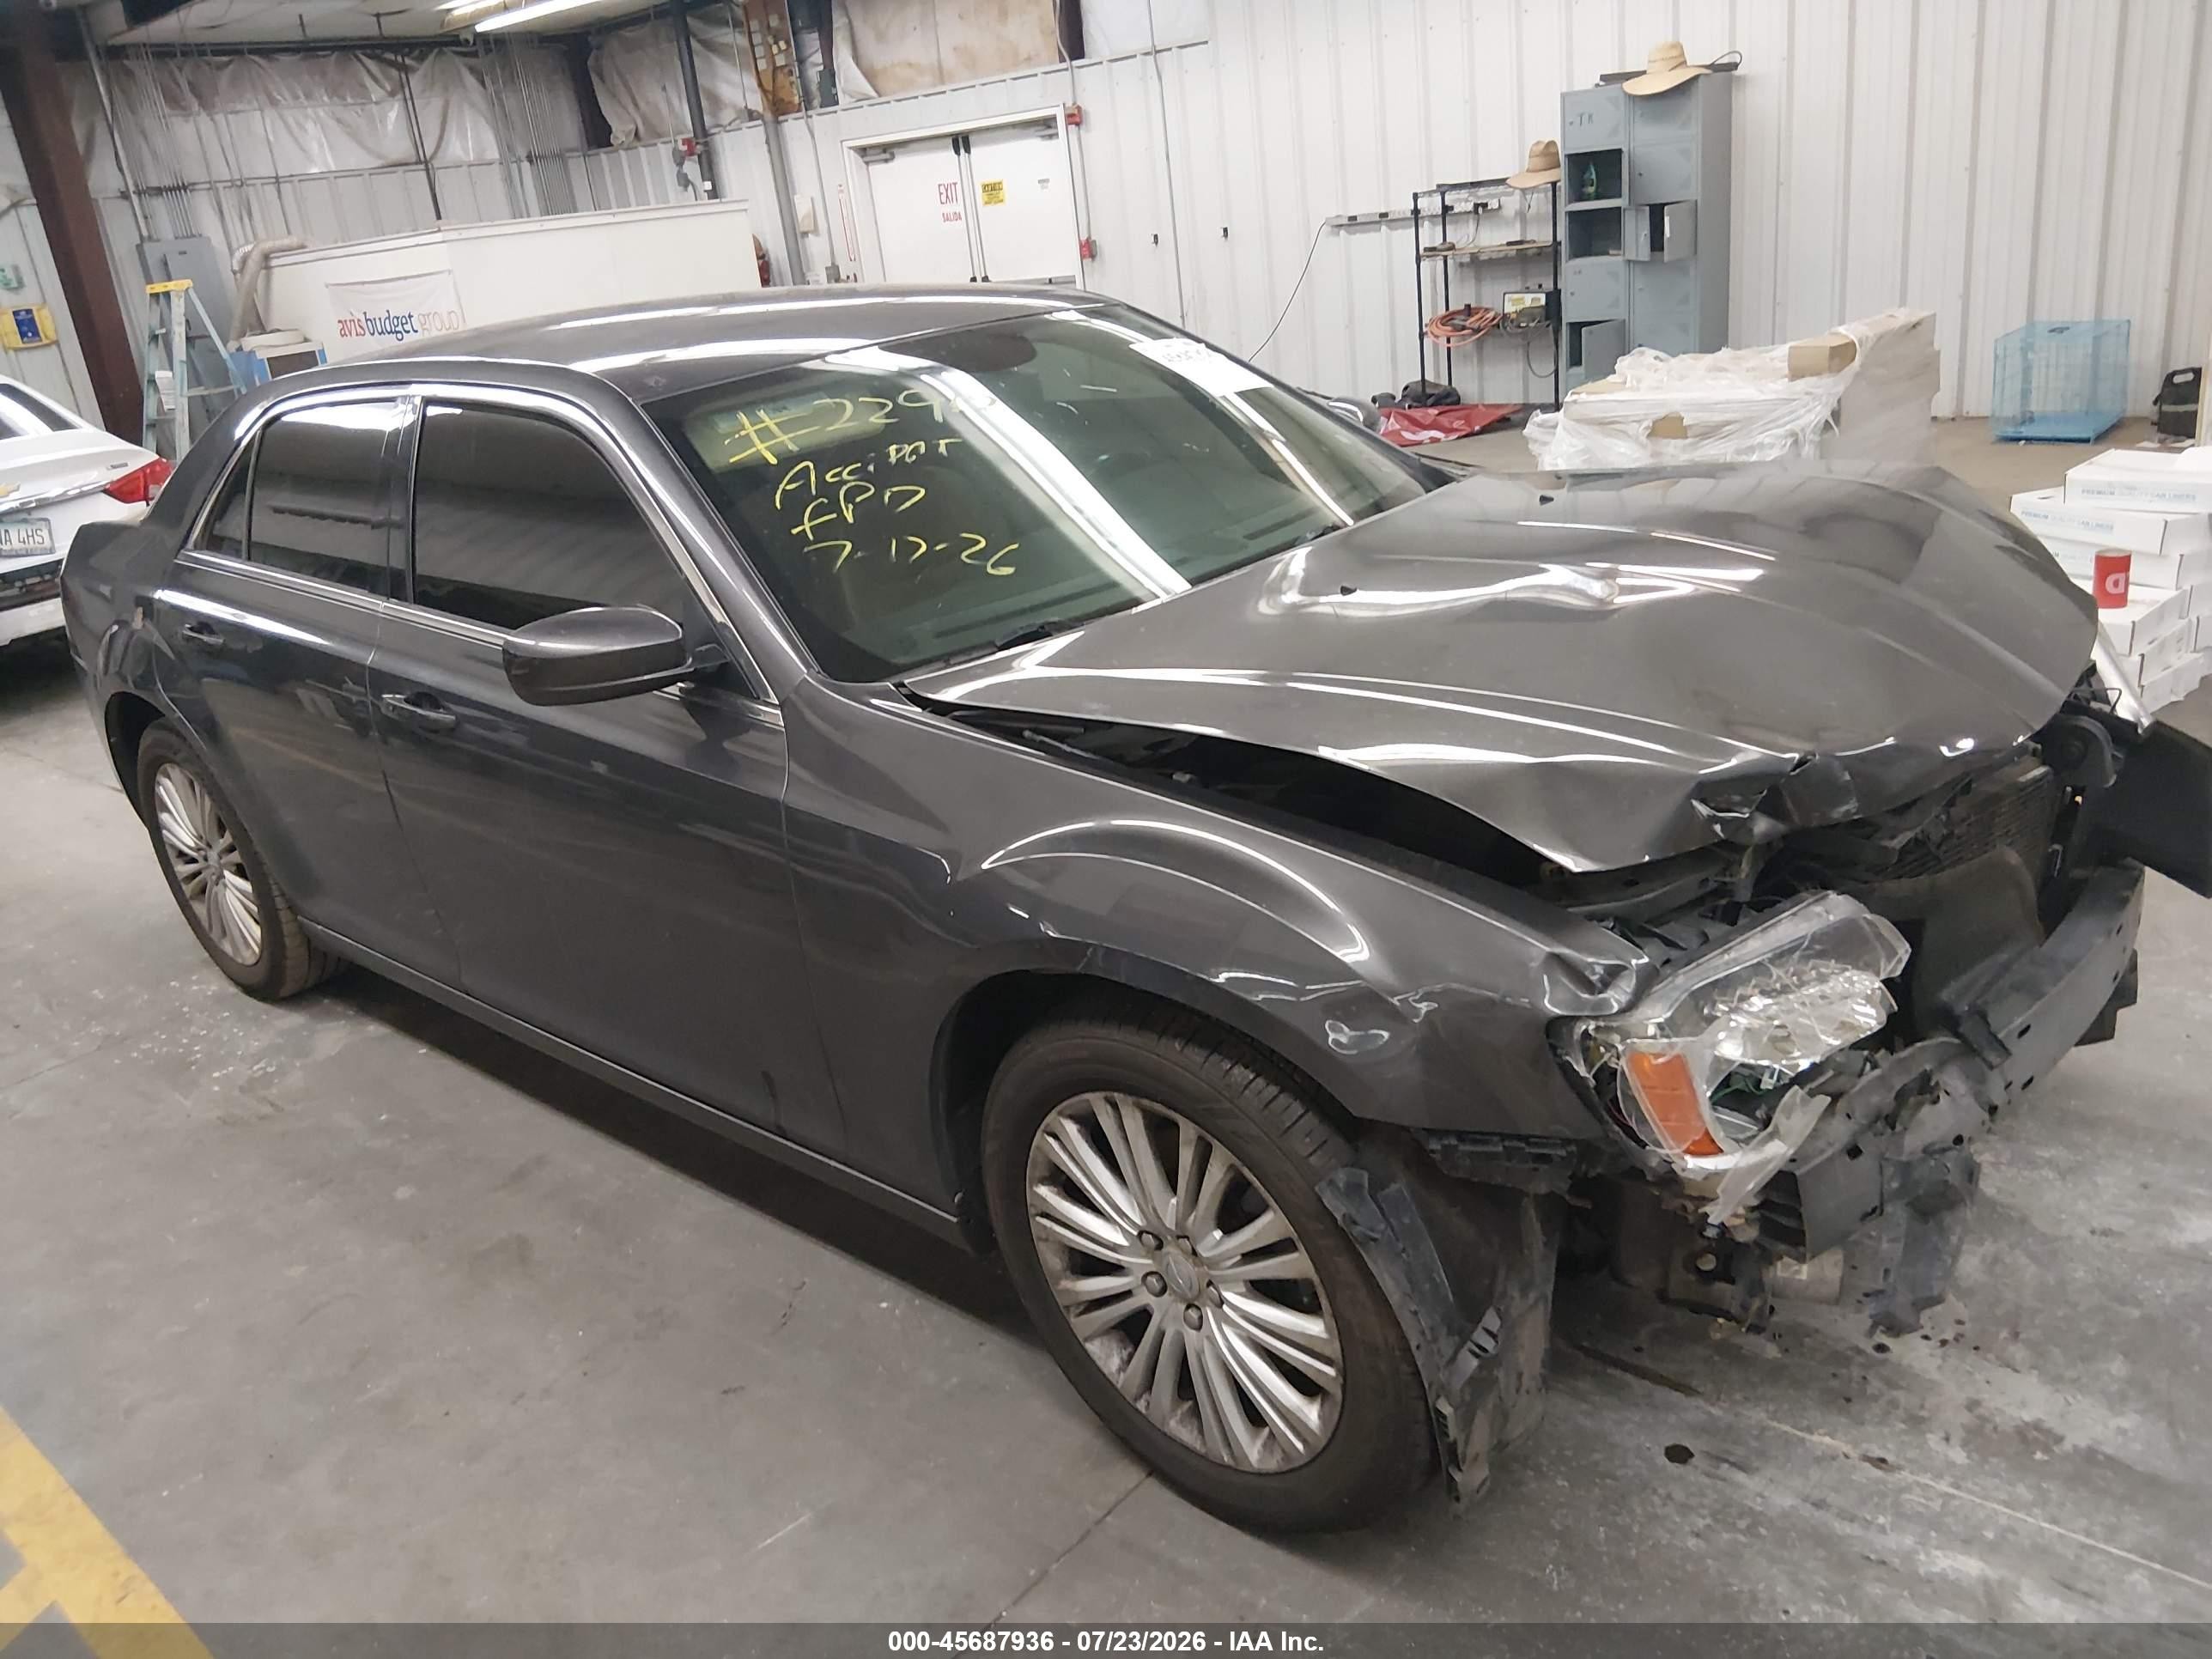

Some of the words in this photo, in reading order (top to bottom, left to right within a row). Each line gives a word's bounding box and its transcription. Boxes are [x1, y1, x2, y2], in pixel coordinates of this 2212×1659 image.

[938, 181, 959, 205] EXIT
[942, 212, 963, 223] SALIDA
[17, 528, 45, 545] 4HS
